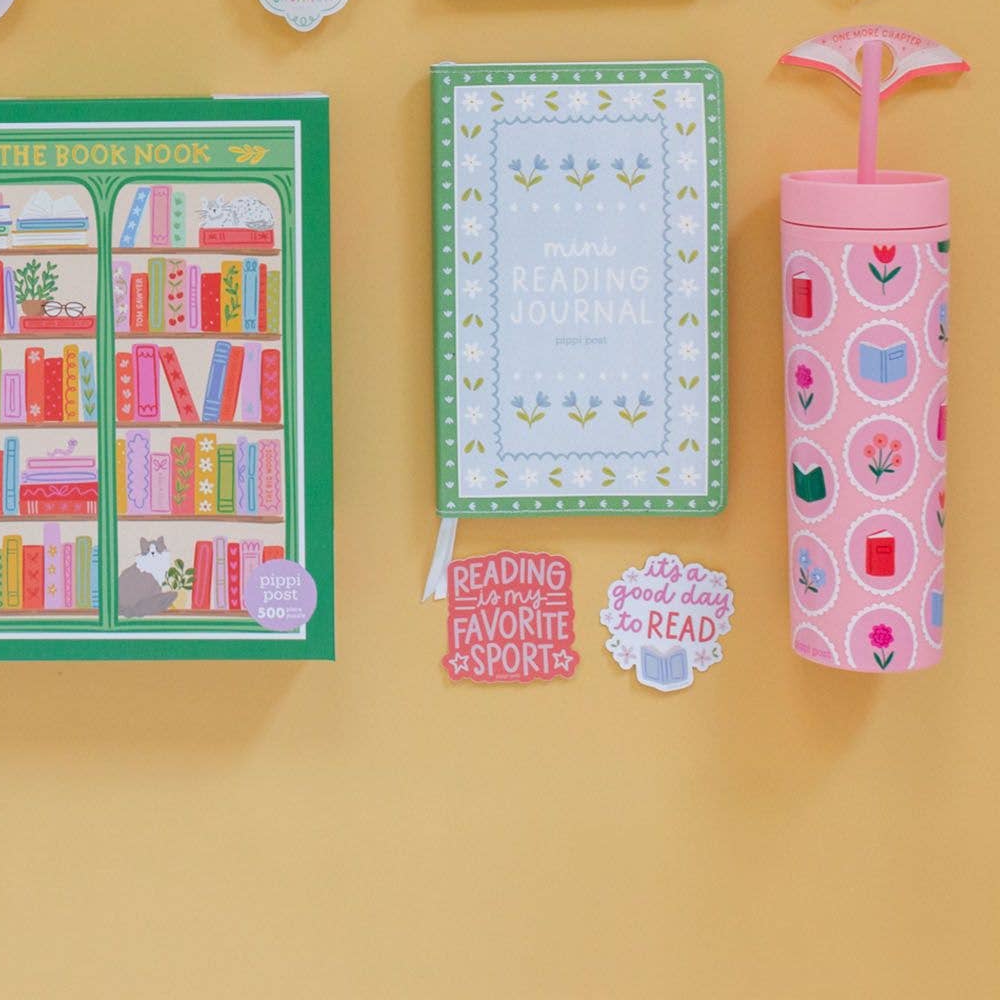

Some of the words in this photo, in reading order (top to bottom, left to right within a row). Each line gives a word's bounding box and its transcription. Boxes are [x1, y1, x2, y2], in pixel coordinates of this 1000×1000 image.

[832, 31, 850, 43] ONE
[853, 27, 880, 39] MORE
[882, 29, 922, 46] CHAPTER
[55, 143, 128, 167] BOOK
[134, 142, 212, 166] NOOK
[543, 237, 617, 257] mini
[512, 266, 649, 293] READING
[135, 278, 144, 309] SAWYER
[135, 311, 144, 327] TOM
[510, 298, 656, 325] JOURNAL
[260, 573, 301, 589] pippi
[453, 556, 566, 597] READING
[644, 557, 683, 583] it's
[686, 567, 708, 582] a
[263, 589, 299, 604] post
[476, 586, 501, 608] is
[504, 588, 548, 610] my
[612, 583, 676, 610] good
[681, 584, 730, 619] day
[257, 607, 286, 619] 500
[453, 606, 569, 649] FAVORITE
[614, 611, 643, 633] to
[647, 610, 716, 643] READ
[470, 641, 554, 676] SPORT
